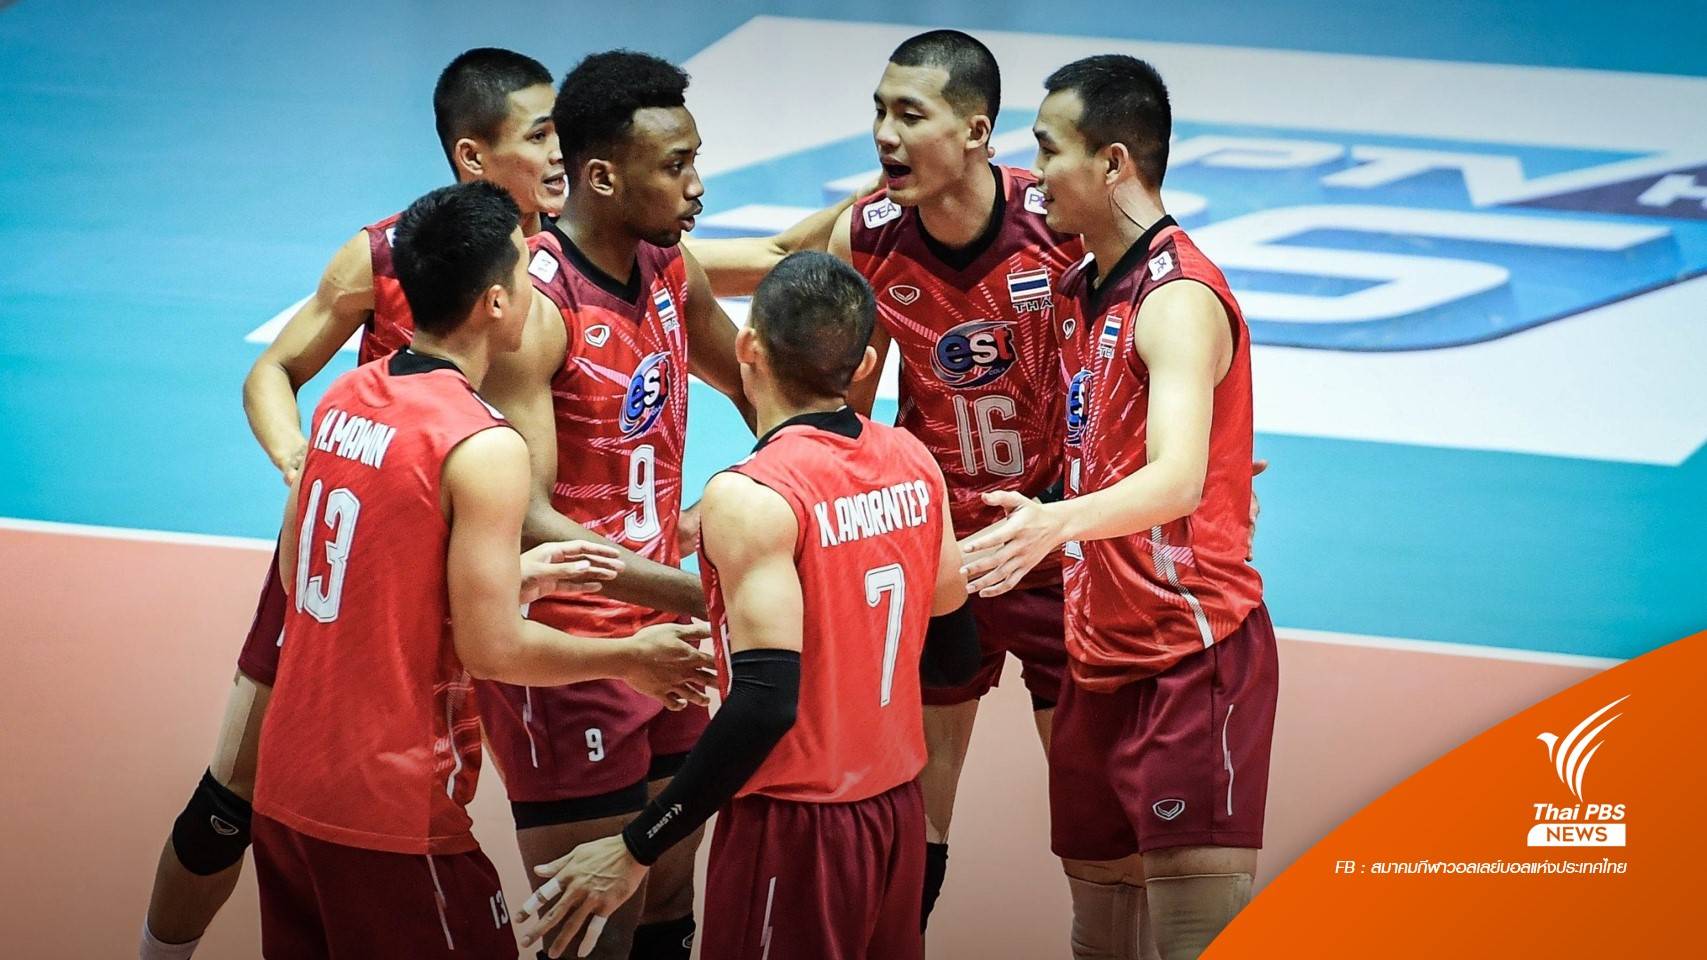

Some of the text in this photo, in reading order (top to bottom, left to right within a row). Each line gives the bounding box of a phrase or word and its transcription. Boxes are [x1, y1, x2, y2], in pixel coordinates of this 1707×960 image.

[867, 202, 897, 222] PEA
[1012, 296, 1054, 314] THA
[935, 325, 1014, 372] est
[627, 360, 667, 418] est
[952, 394, 1024, 477] 16
[624, 444, 662, 541] 9
[813, 479, 930, 548] K.AMORNTEP
[296, 478, 361, 624] 13
[865, 563, 906, 708] 7
[585, 728, 605, 762] 9
[490, 889, 509, 929] 13
